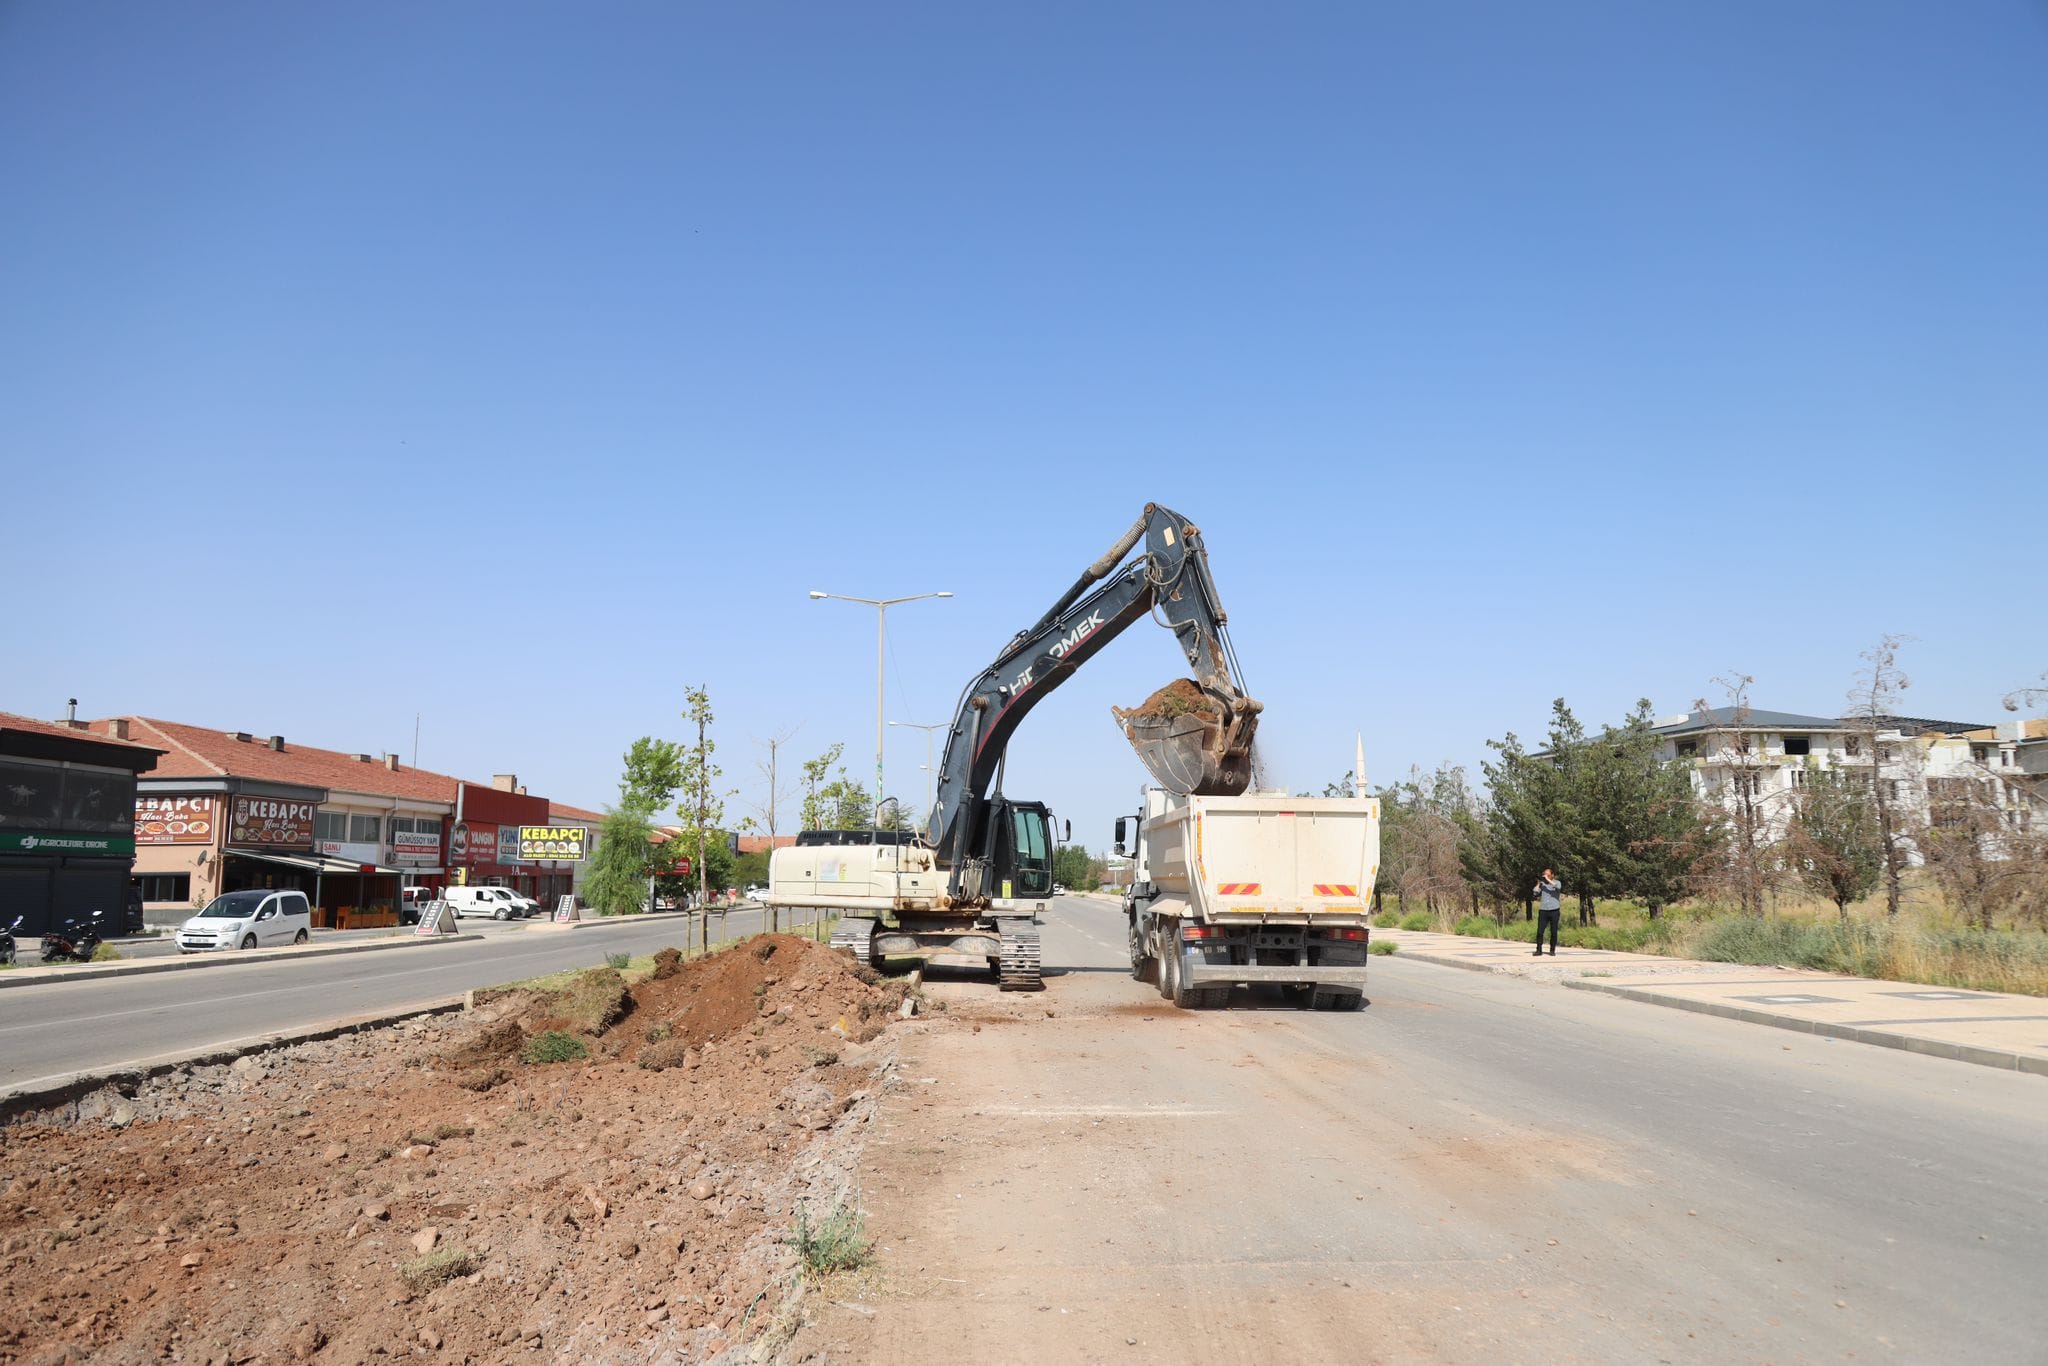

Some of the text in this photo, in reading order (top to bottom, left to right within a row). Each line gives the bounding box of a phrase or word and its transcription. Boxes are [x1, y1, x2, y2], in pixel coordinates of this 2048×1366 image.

[135, 797, 210, 812] EBAPÇI
[249, 800, 313, 822] KEBAPÇI
[471, 831, 495, 845] YANGIN
[522, 828, 584, 841] KEBAPÇI
[39, 839, 84, 848] AGRICULTURE
[86, 841, 108, 849] DRONE
